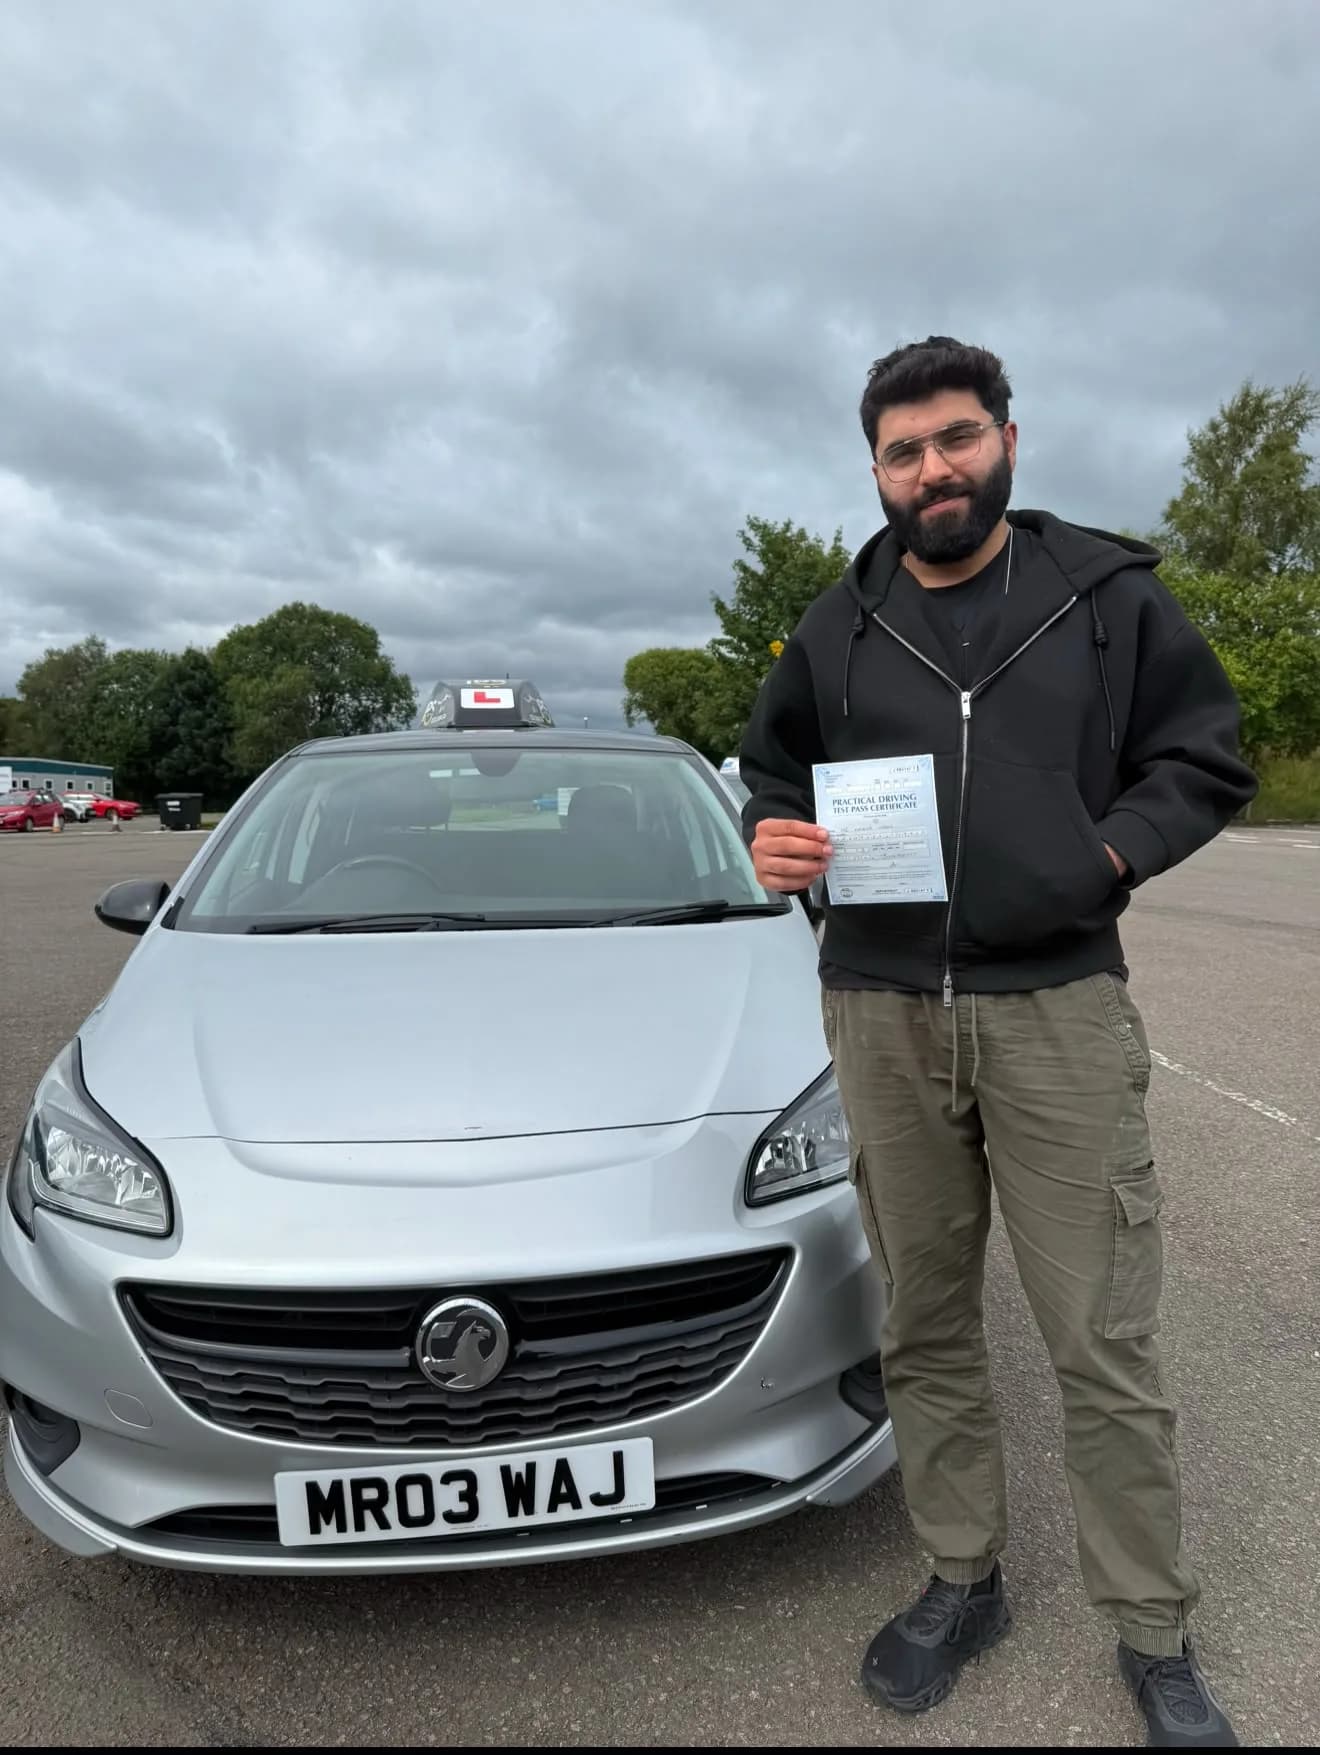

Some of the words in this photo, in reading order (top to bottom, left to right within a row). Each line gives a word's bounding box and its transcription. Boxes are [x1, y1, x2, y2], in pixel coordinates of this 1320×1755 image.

[474, 691, 501, 703] L
[832, 796, 876, 806] PRACTICAL
[878, 792, 917, 803] DRIVING
[833, 806, 849, 814] TEST
[851, 804, 869, 813] PASS
[870, 801, 918, 812] CERTIFICATE
[305, 1468, 480, 1535] MR03
[499, 1450, 625, 1518] WAJ
